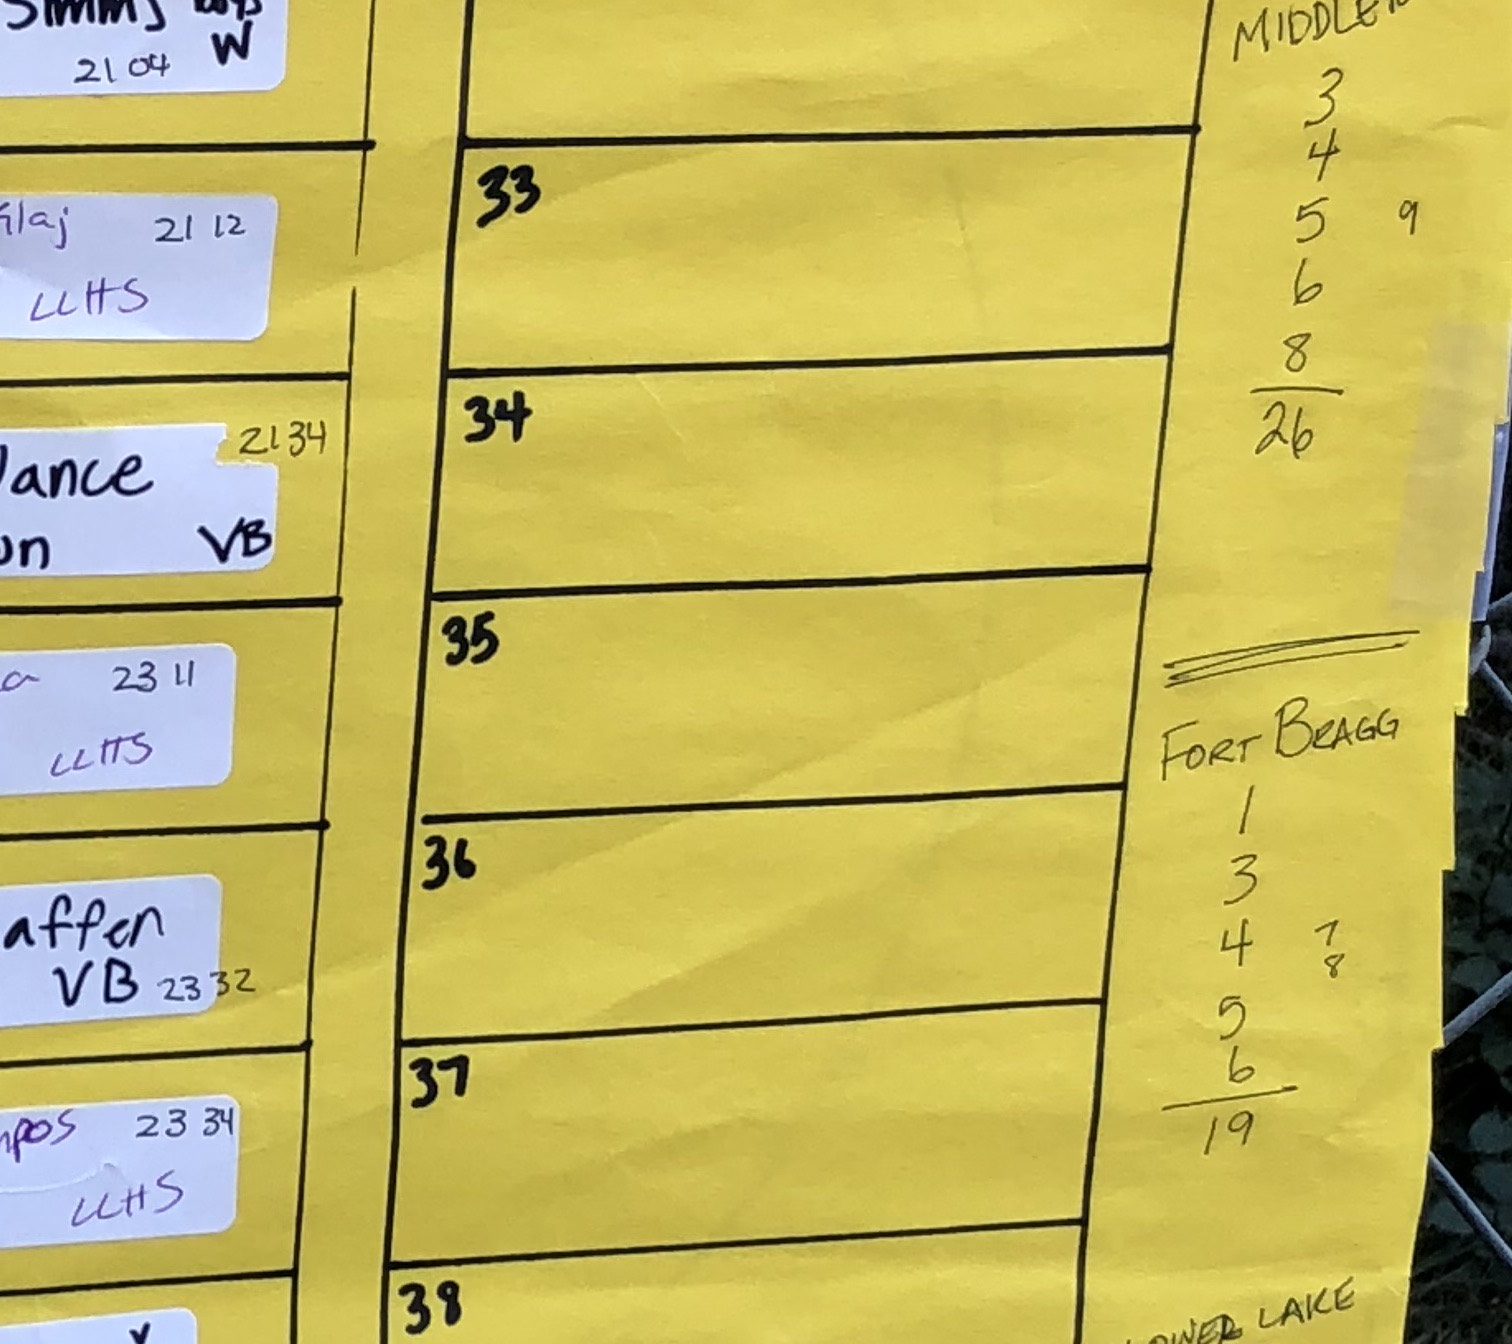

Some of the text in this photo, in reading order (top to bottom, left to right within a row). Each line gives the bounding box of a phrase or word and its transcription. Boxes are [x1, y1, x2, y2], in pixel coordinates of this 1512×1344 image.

[210, 15, 257, 67] W
[1303, 67, 1344, 135] 3
[1307, 127, 1341, 183] 4
[475, 164, 542, 229] 33
[1296, 197, 1329, 244] 5
[1398, 200, 1419, 235] 9
[1293, 257, 1323, 306] 6
[1283, 332, 1312, 373] 8
[463, 389, 533, 443] 34
[1255, 398, 1315, 460] 26
[196, 517, 273, 565] VB
[441, 610, 500, 667] 35
[1238, 785, 1255, 835] 1
[421, 834, 477, 891] 36
[1223, 854, 1258, 906] 3
[1220, 918, 1254, 967] 4
[1314, 919, 1339, 947] 7
[51, 956, 139, 1008] VB
[1324, 953, 1346, 979] 8
[1218, 995, 1246, 1041] 5
[408, 1054, 470, 1109] 37
[1228, 1045, 1255, 1084] 6
[1204, 1110, 1254, 1155] 19
[397, 1280, 462, 1336] 38
[1258, 1276, 1355, 1329] LAKE
